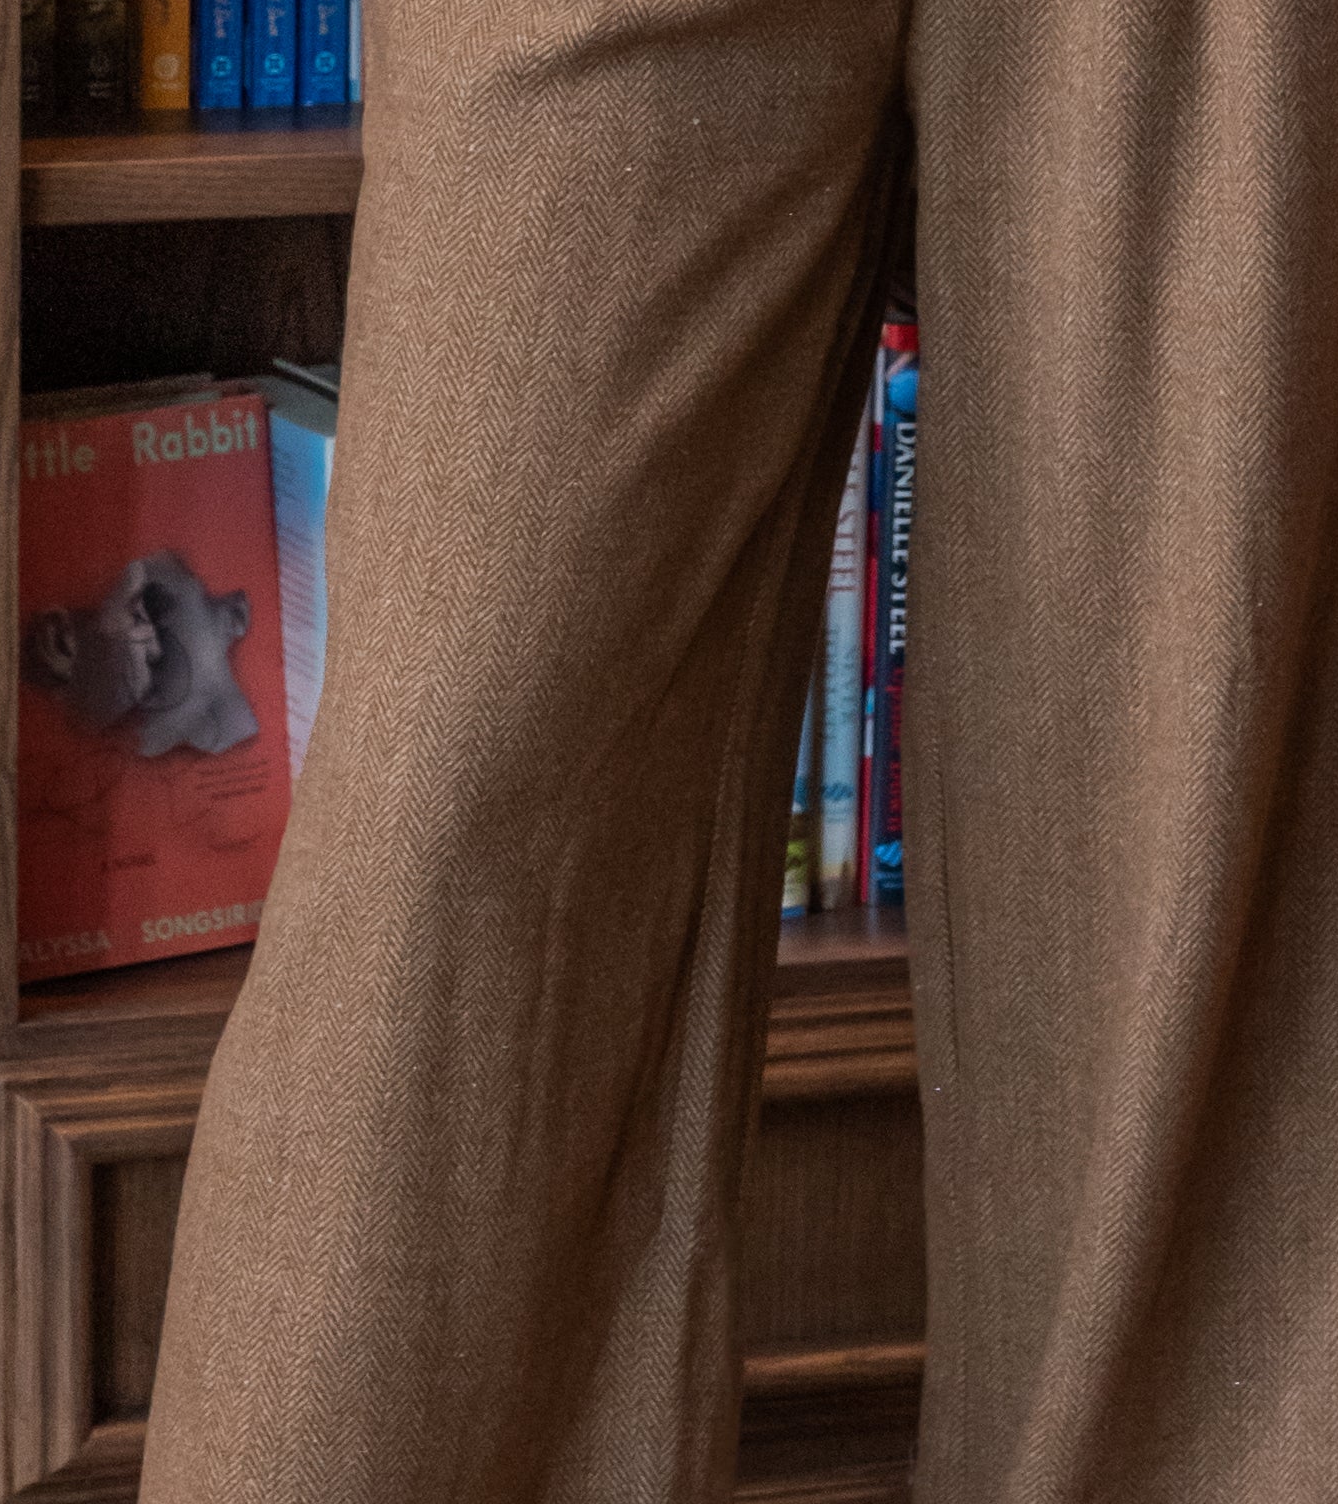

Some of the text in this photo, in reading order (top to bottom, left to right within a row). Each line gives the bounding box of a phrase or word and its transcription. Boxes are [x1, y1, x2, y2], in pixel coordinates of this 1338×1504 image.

[132, 411, 260, 467] Rabbit
[889, 421, 917, 657] DANIELLE STEEL
